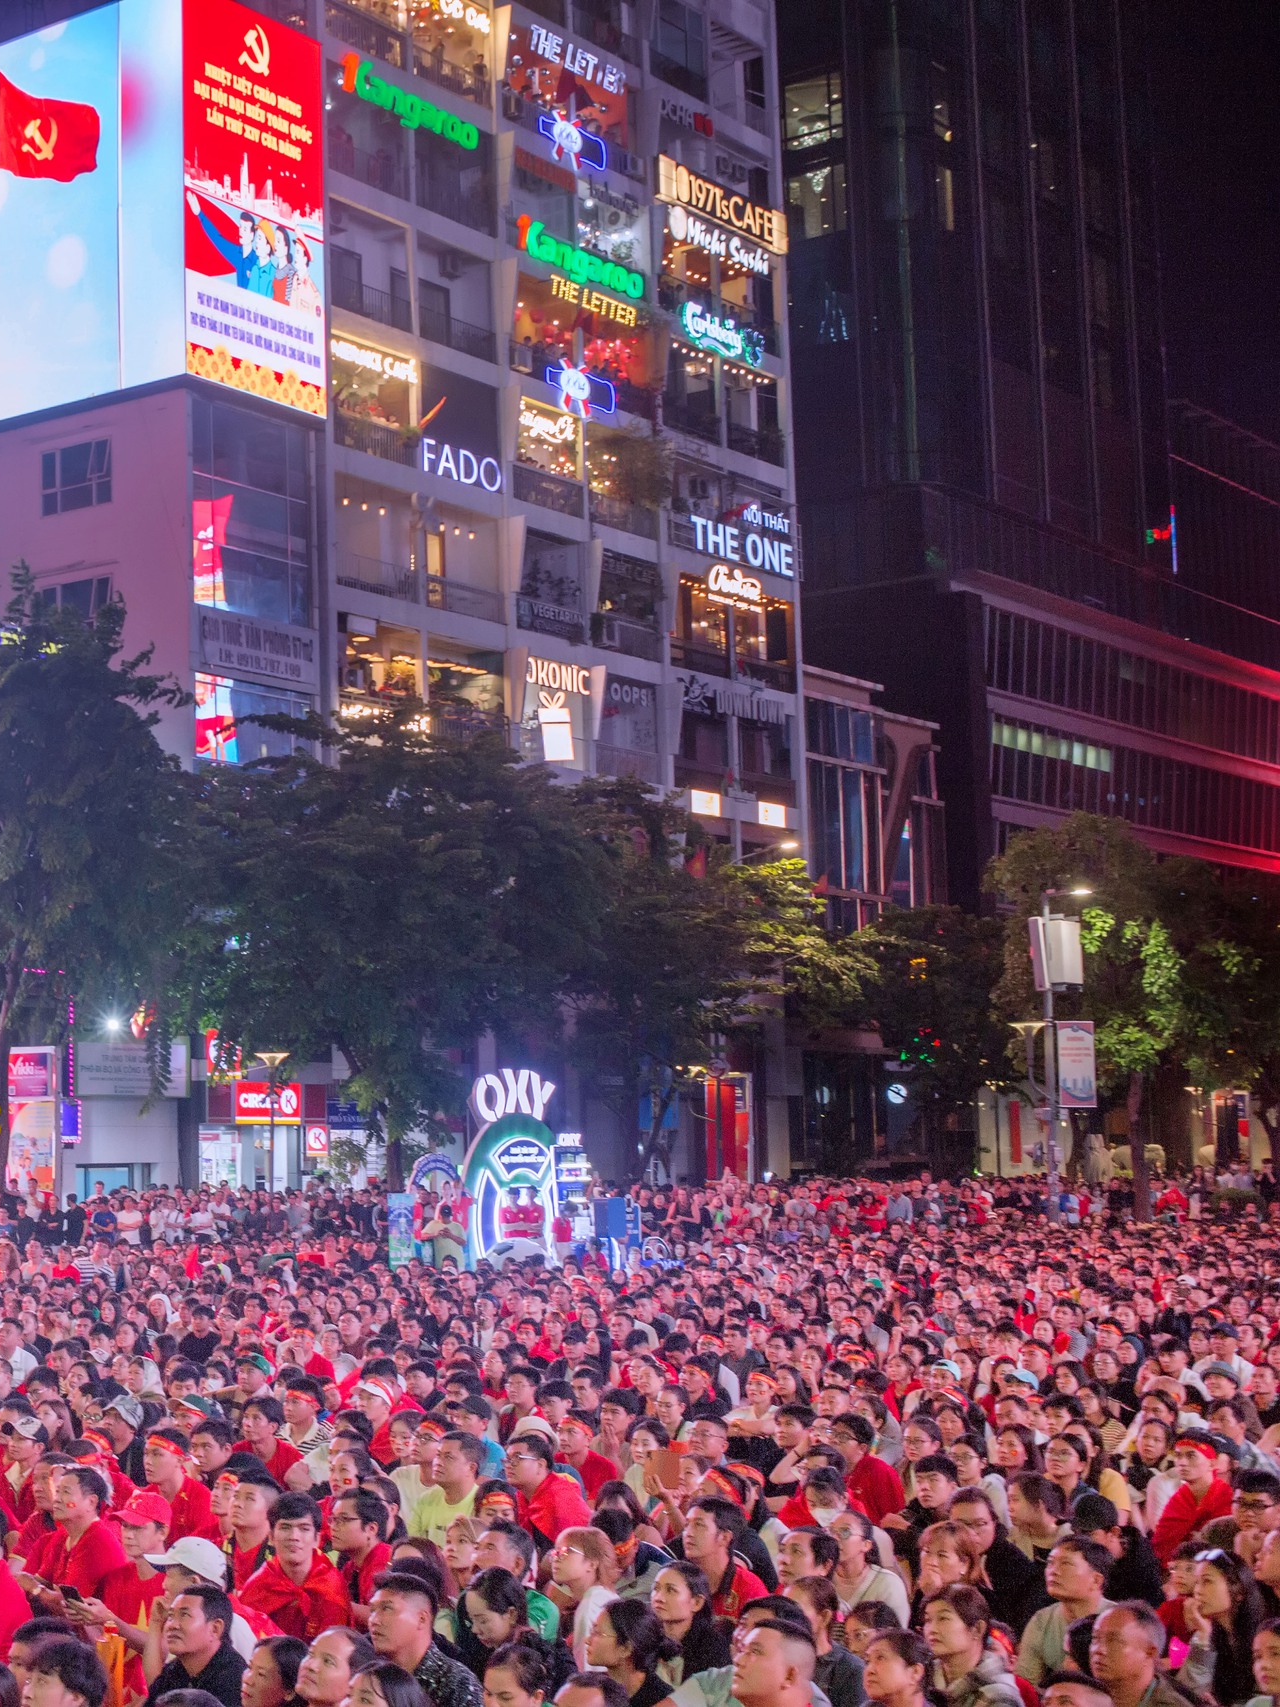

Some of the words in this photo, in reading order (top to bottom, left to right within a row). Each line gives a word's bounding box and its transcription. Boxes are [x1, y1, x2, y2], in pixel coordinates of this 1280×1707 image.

[530, 24, 563, 64] THE
[244, 124, 260, 143] XIV
[687, 216, 727, 256] Michi
[729, 236, 769, 275] Sushi
[550, 274, 580, 304] THE
[581, 288, 637, 327] LETTER
[682, 301, 743, 356] Carlsberg
[423, 438, 502, 492] FADO
[743, 504, 761, 527] NỘI
[762, 512, 790, 534] THẤT
[690, 515, 740, 561] THE
[745, 533, 795, 577] ONE
[476, 1068, 556, 1122] OXY
[558, 1133, 581, 1146] OXY
